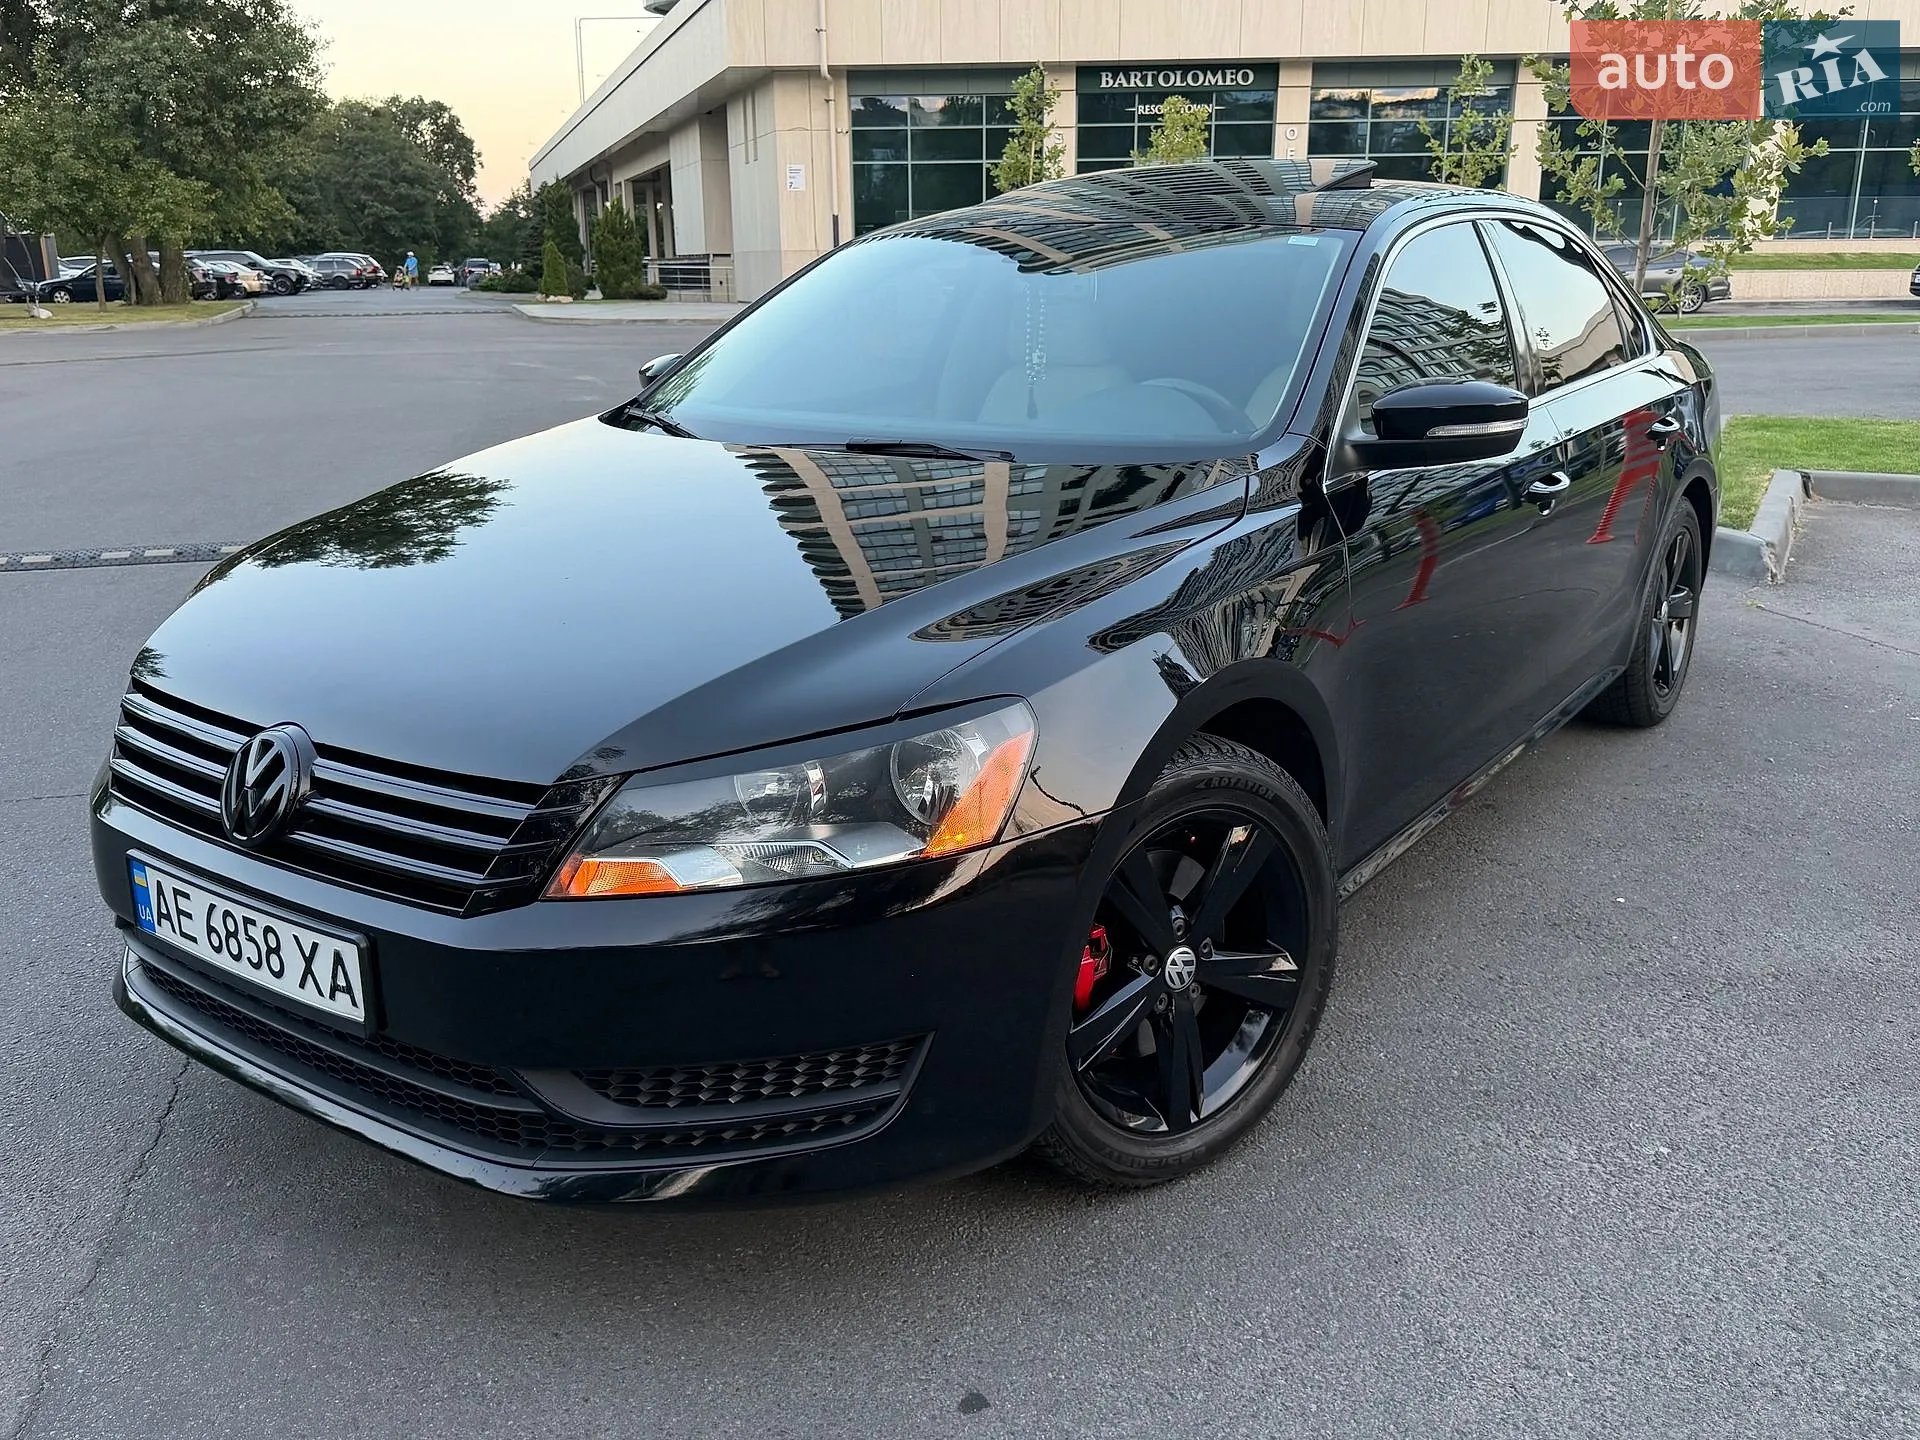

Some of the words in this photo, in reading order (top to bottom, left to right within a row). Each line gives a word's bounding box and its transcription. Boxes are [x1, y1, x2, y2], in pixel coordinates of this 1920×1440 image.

[1099, 69, 1254, 88] BARTOLOMEO
[138, 903, 154, 922] UA
[156, 879, 199, 945] AE
[206, 903, 285, 979] 6858
[292, 933, 359, 1009] XA
